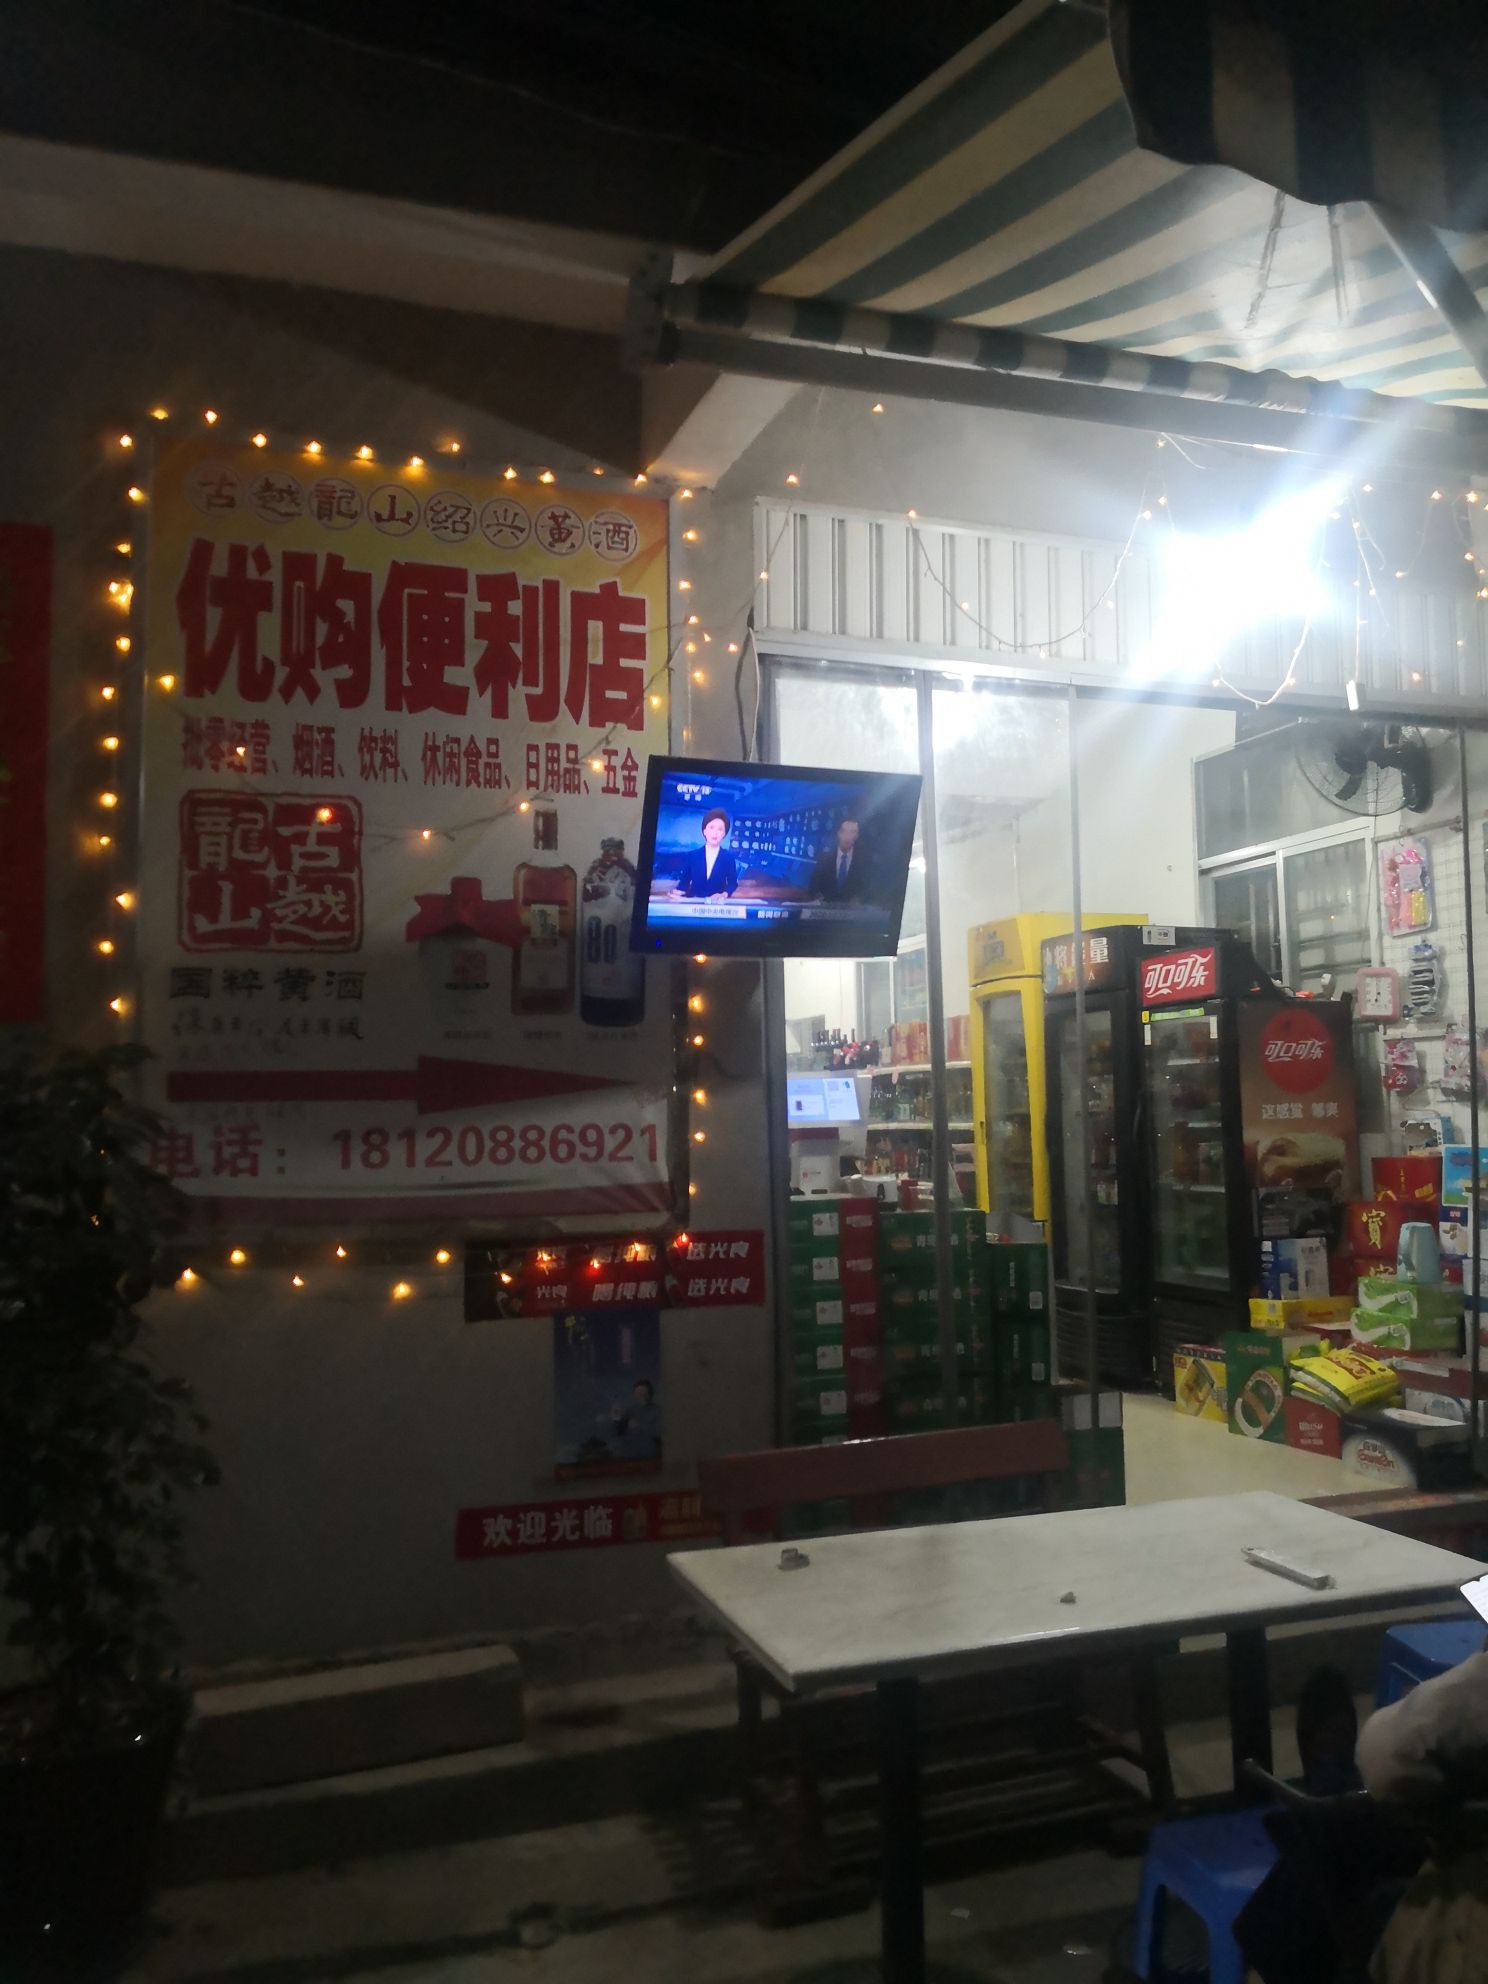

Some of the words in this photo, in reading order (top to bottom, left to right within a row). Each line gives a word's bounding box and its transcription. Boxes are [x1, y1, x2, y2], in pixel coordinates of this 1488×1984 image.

[176, 537, 647, 731] 优购便利店
[1144, 953, 1213, 998] 可口可乐
[1264, 1038, 1327, 1062] 可口可乐
[332, 1122, 657, 1170] 18120886921
[482, 1505, 614, 1548] 欢迎光临
